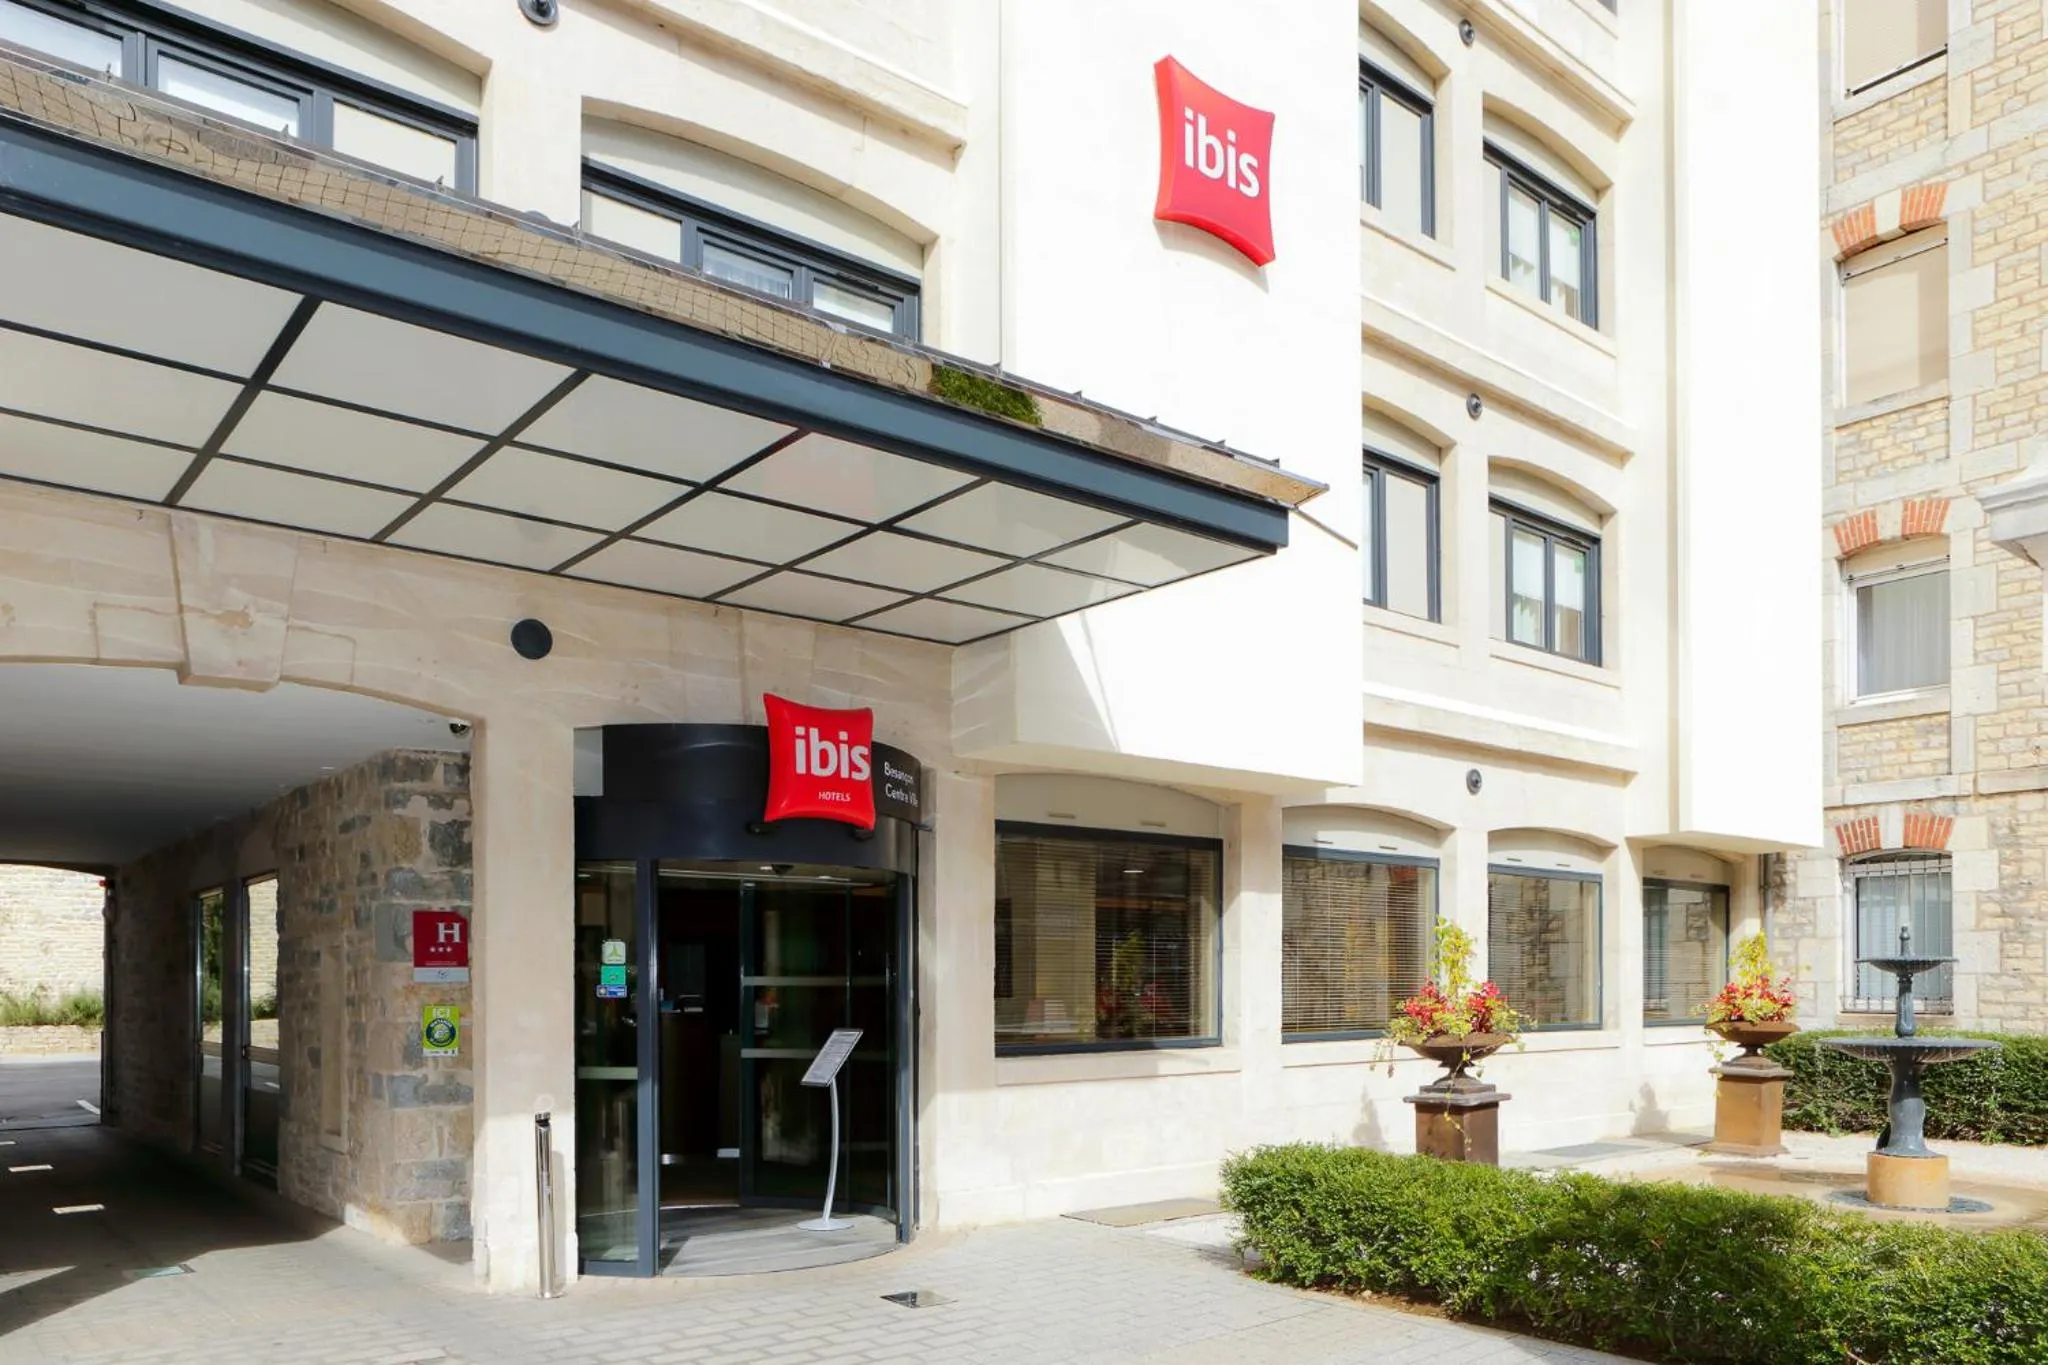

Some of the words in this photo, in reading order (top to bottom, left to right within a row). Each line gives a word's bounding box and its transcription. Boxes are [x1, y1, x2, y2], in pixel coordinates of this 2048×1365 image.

[1184, 105, 1260, 198] ibis
[794, 726, 871, 781] ibis
[818, 791, 851, 802] HOTELS
[437, 922, 462, 943] H
